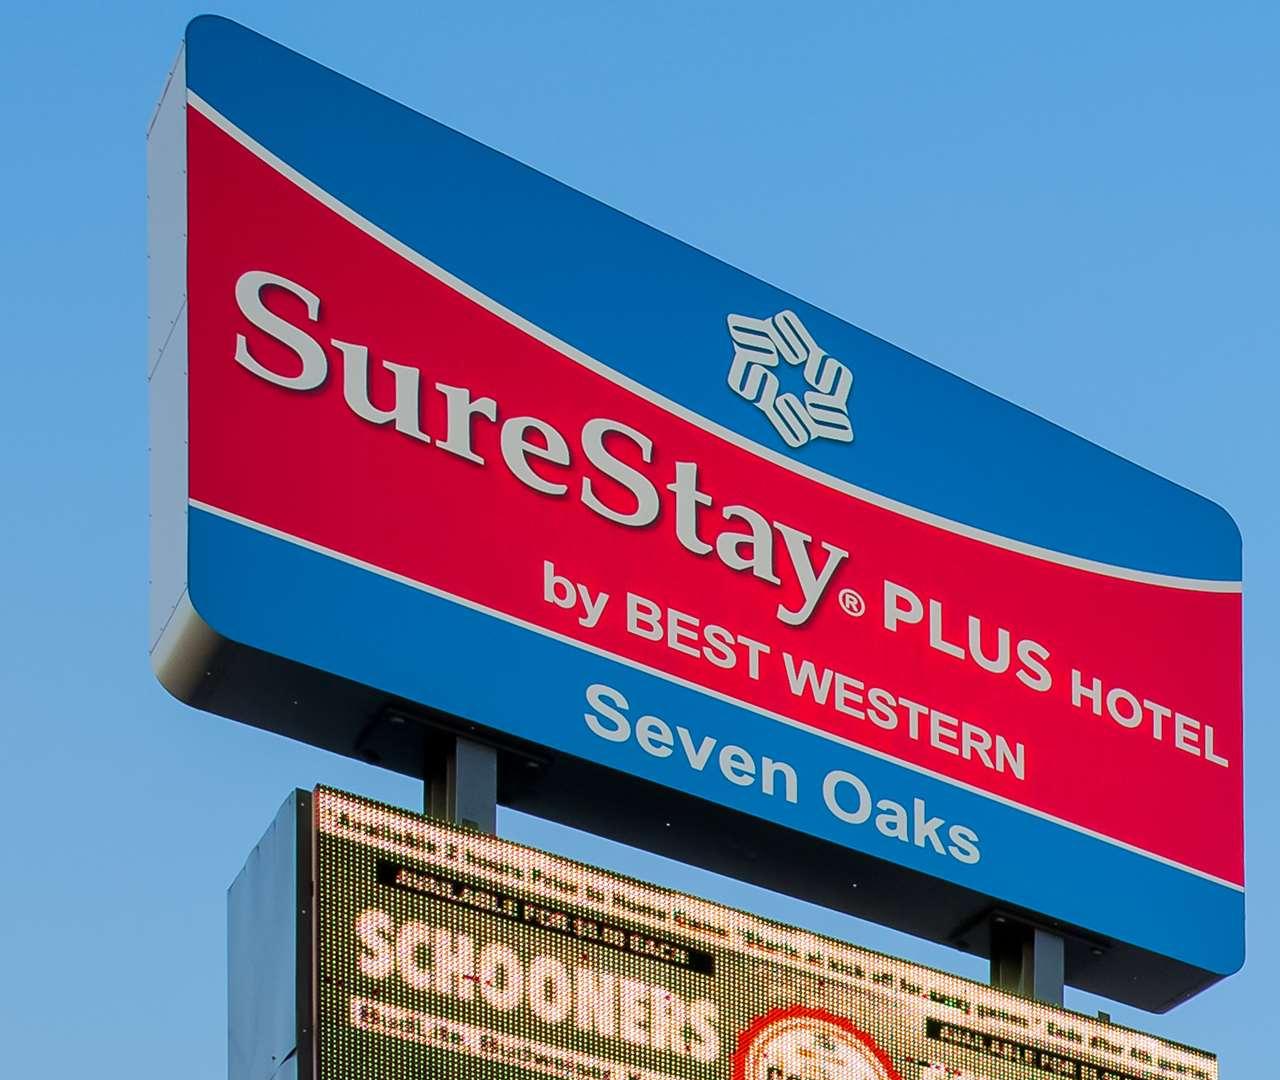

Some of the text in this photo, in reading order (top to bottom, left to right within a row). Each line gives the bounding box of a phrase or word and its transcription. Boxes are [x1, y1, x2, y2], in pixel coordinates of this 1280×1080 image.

[544, 561, 1025, 780] by BEST WESTERN
[884, 580, 1052, 691] PLUS
[1072, 669, 1228, 768] HOTEL
[585, 684, 980, 864] Seven Oaks
[356, 903, 720, 1068] SCHOONERS
[523, 902, 568, 933] FOR
[629, 932, 688, 966] EACH
[532, 867, 577, 896] Prior
[612, 891, 666, 922] Home
[829, 955, 863, 979] kick
[1047, 1020, 1082, 1044] Ends
[1040, 1052, 1075, 1077] FOR
